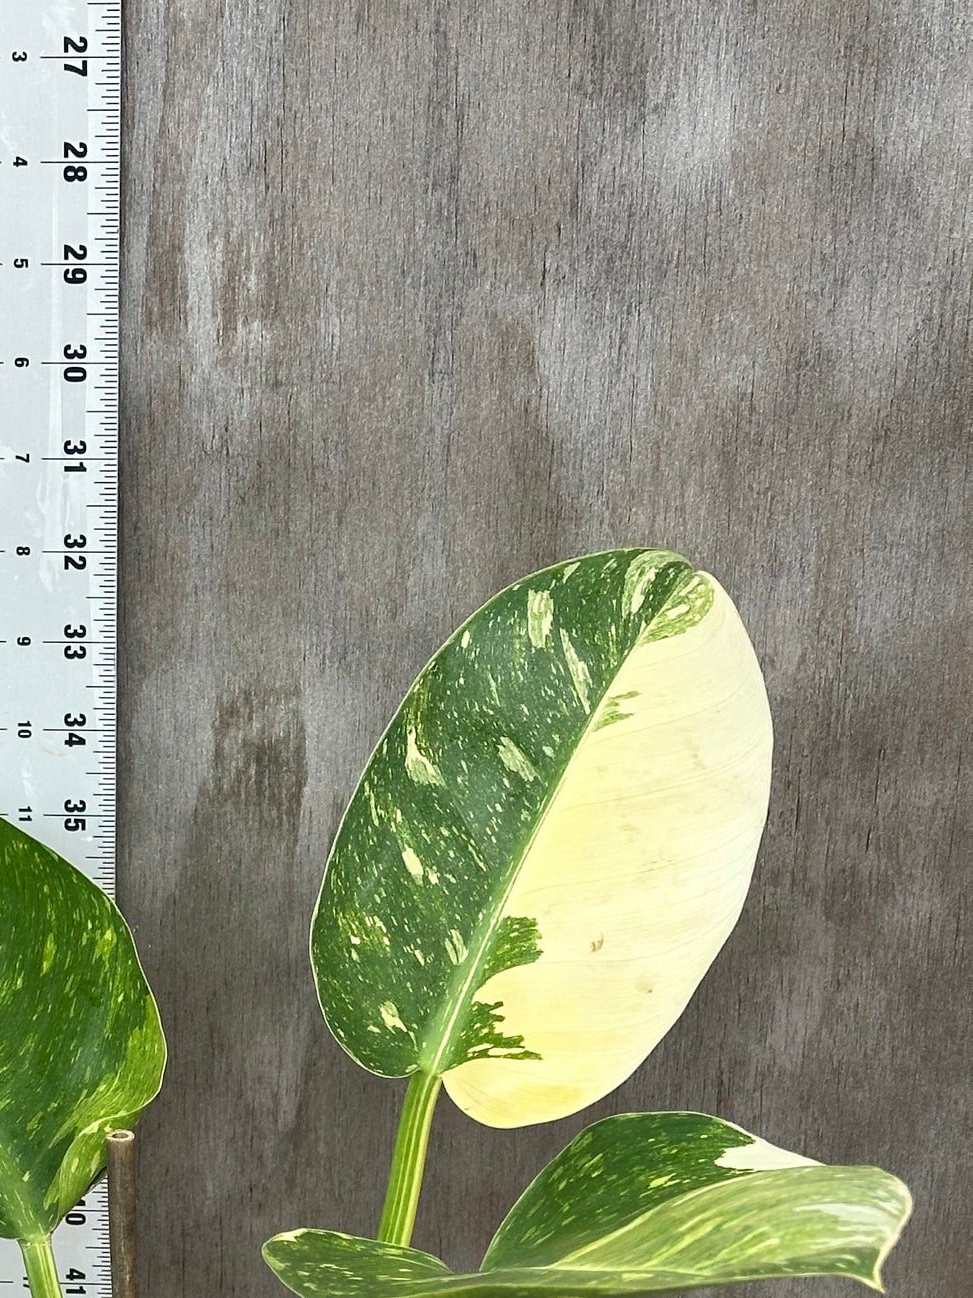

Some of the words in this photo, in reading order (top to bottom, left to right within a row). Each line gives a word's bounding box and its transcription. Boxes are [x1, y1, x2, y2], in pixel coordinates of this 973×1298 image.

[11, 51, 28, 63] 3
[63, 36, 88, 77] 27
[12, 156, 28, 168] 4
[63, 141, 88, 183] 28
[13, 258, 29, 269] 5
[63, 244, 88, 285] 29
[14, 357, 30, 368] 6
[63, 344, 87, 383] 30
[15, 453, 30, 464] 7
[63, 439, 87, 473] 31
[16, 546, 31, 556] 8
[63, 533, 87, 570] 32
[16, 636, 31, 647] 9
[63, 624, 87, 660] 33
[17, 720, 32, 739] 10
[63, 713, 87, 748] 34
[18, 805, 33, 823] 11
[63, 799, 87, 832] 35
[65, 1267, 87, 1295] 41
